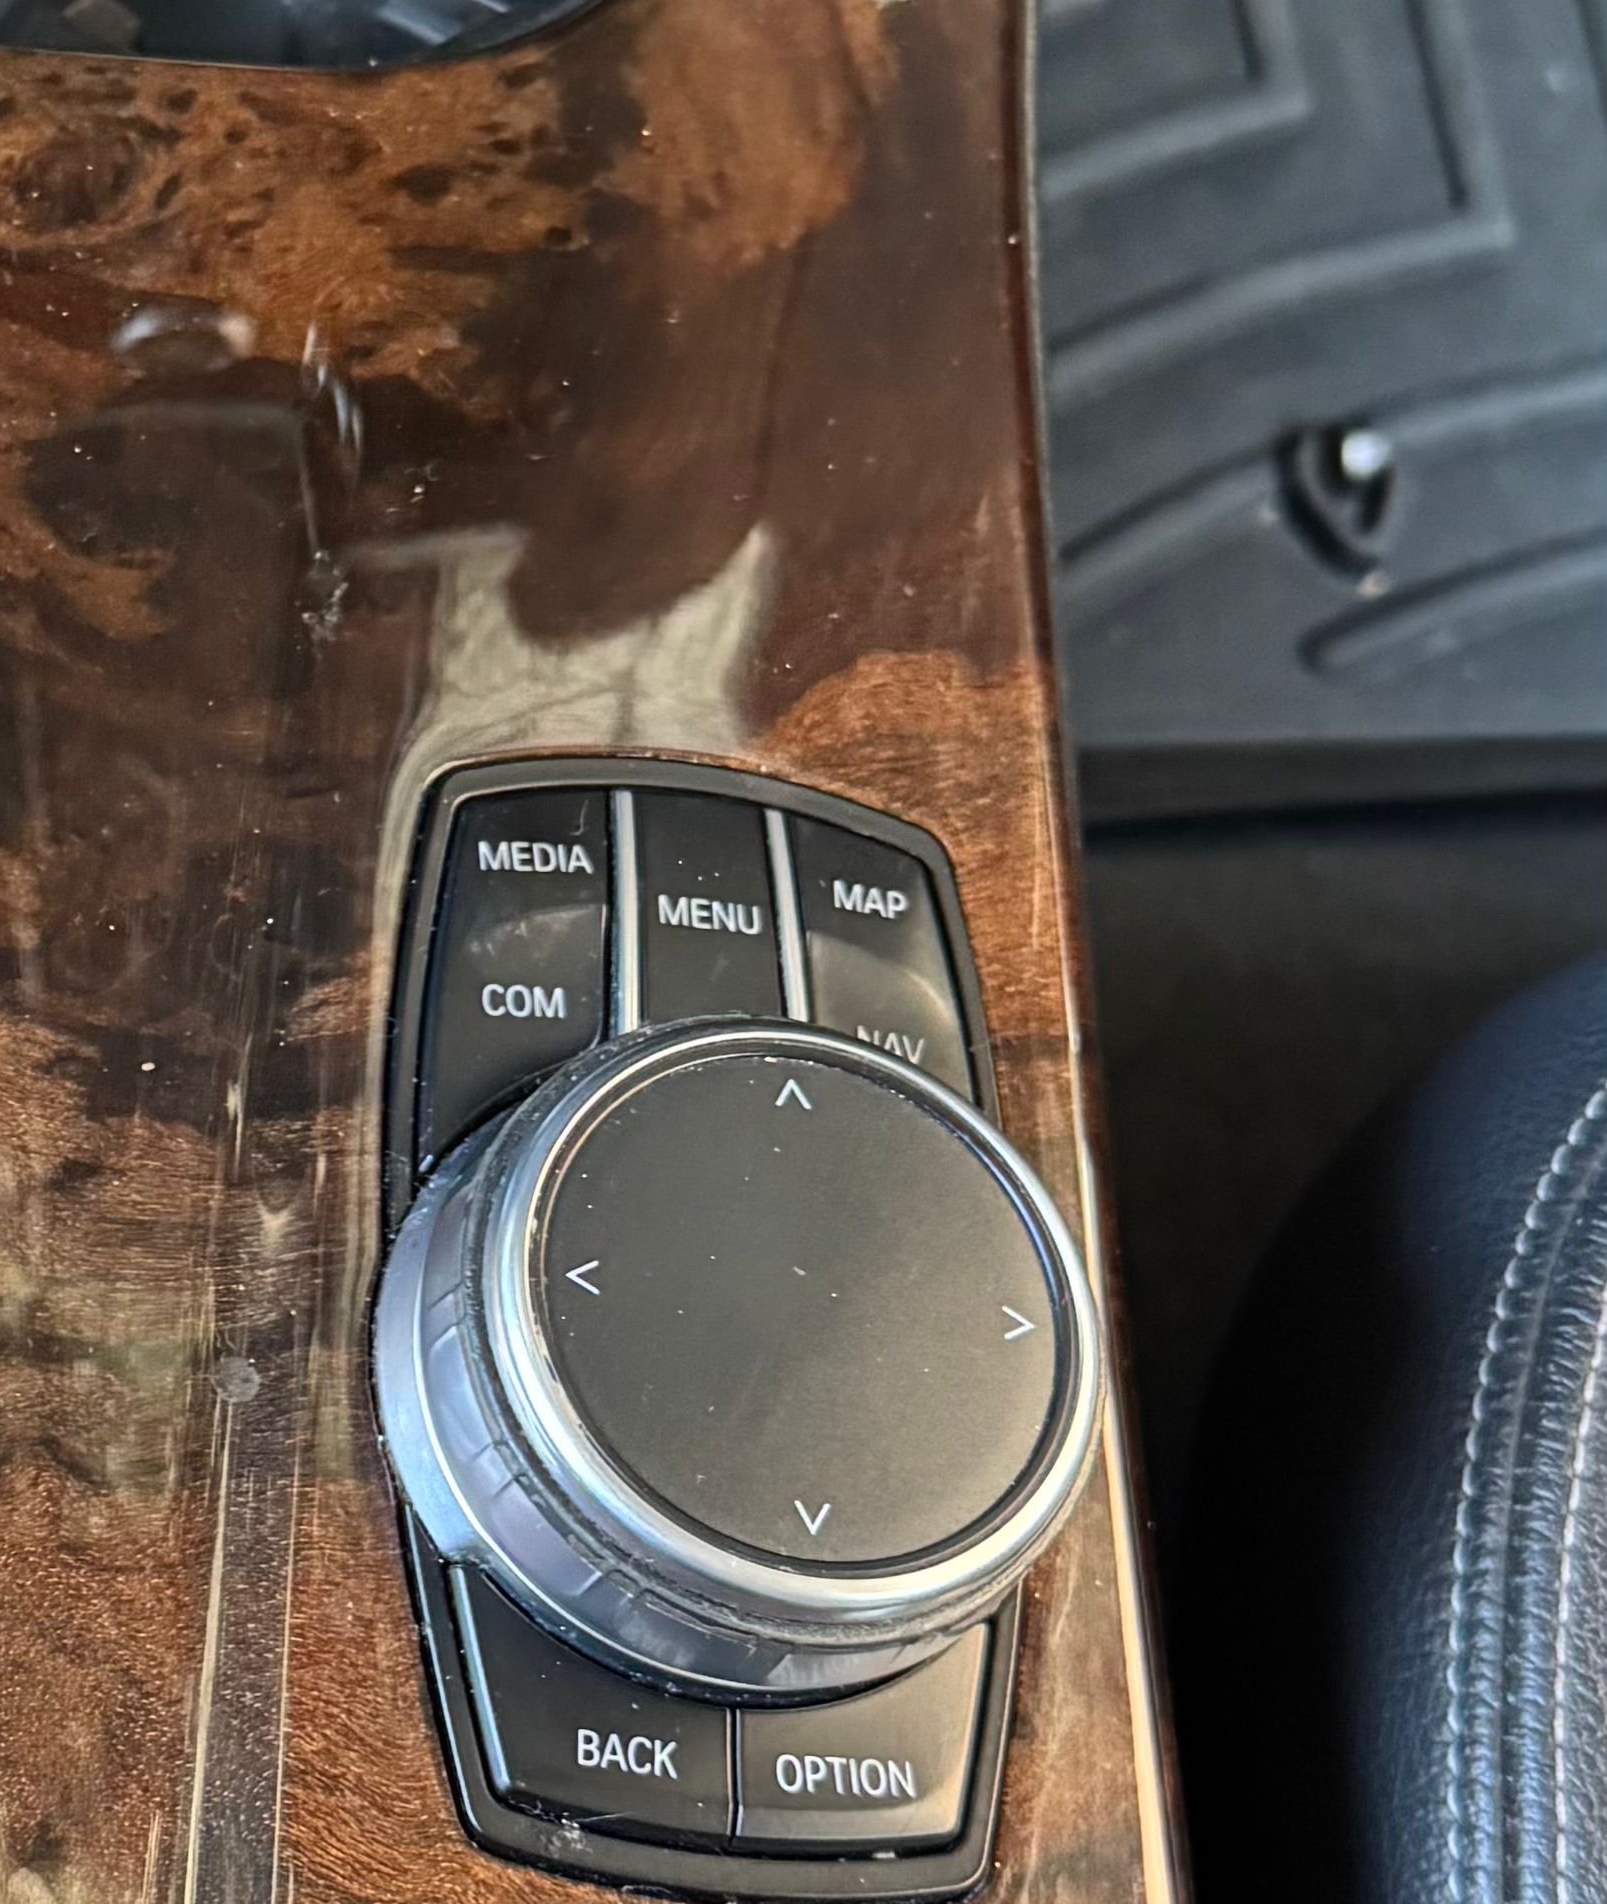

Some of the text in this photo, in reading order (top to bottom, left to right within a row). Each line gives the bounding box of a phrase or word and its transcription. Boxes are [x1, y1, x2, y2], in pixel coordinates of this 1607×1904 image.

[477, 840, 594, 876] MEDIA
[657, 893, 763, 936] MENU
[832, 879, 910, 923] MAP
[480, 982, 567, 1020] COM
[577, 1727, 678, 1780] BACK
[775, 1753, 918, 1799] OPTION
